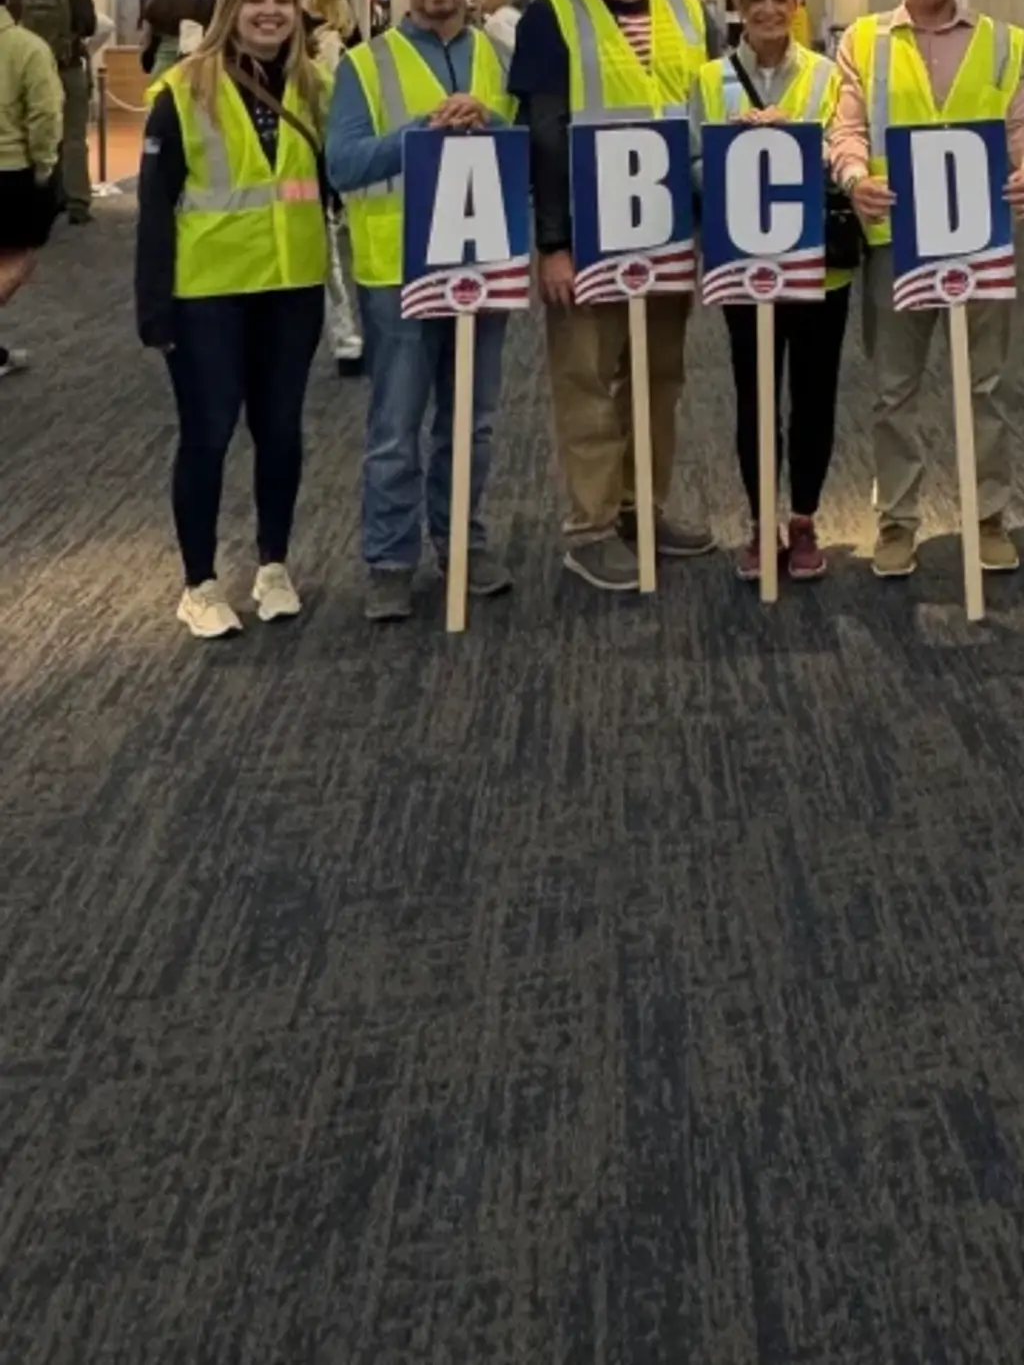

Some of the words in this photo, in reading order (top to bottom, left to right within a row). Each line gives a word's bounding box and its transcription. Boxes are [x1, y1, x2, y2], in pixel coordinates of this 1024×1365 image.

[426, 135, 511, 265] A
[595, 128, 675, 252] B
[725, 127, 804, 255] C
[910, 129, 992, 257] D
